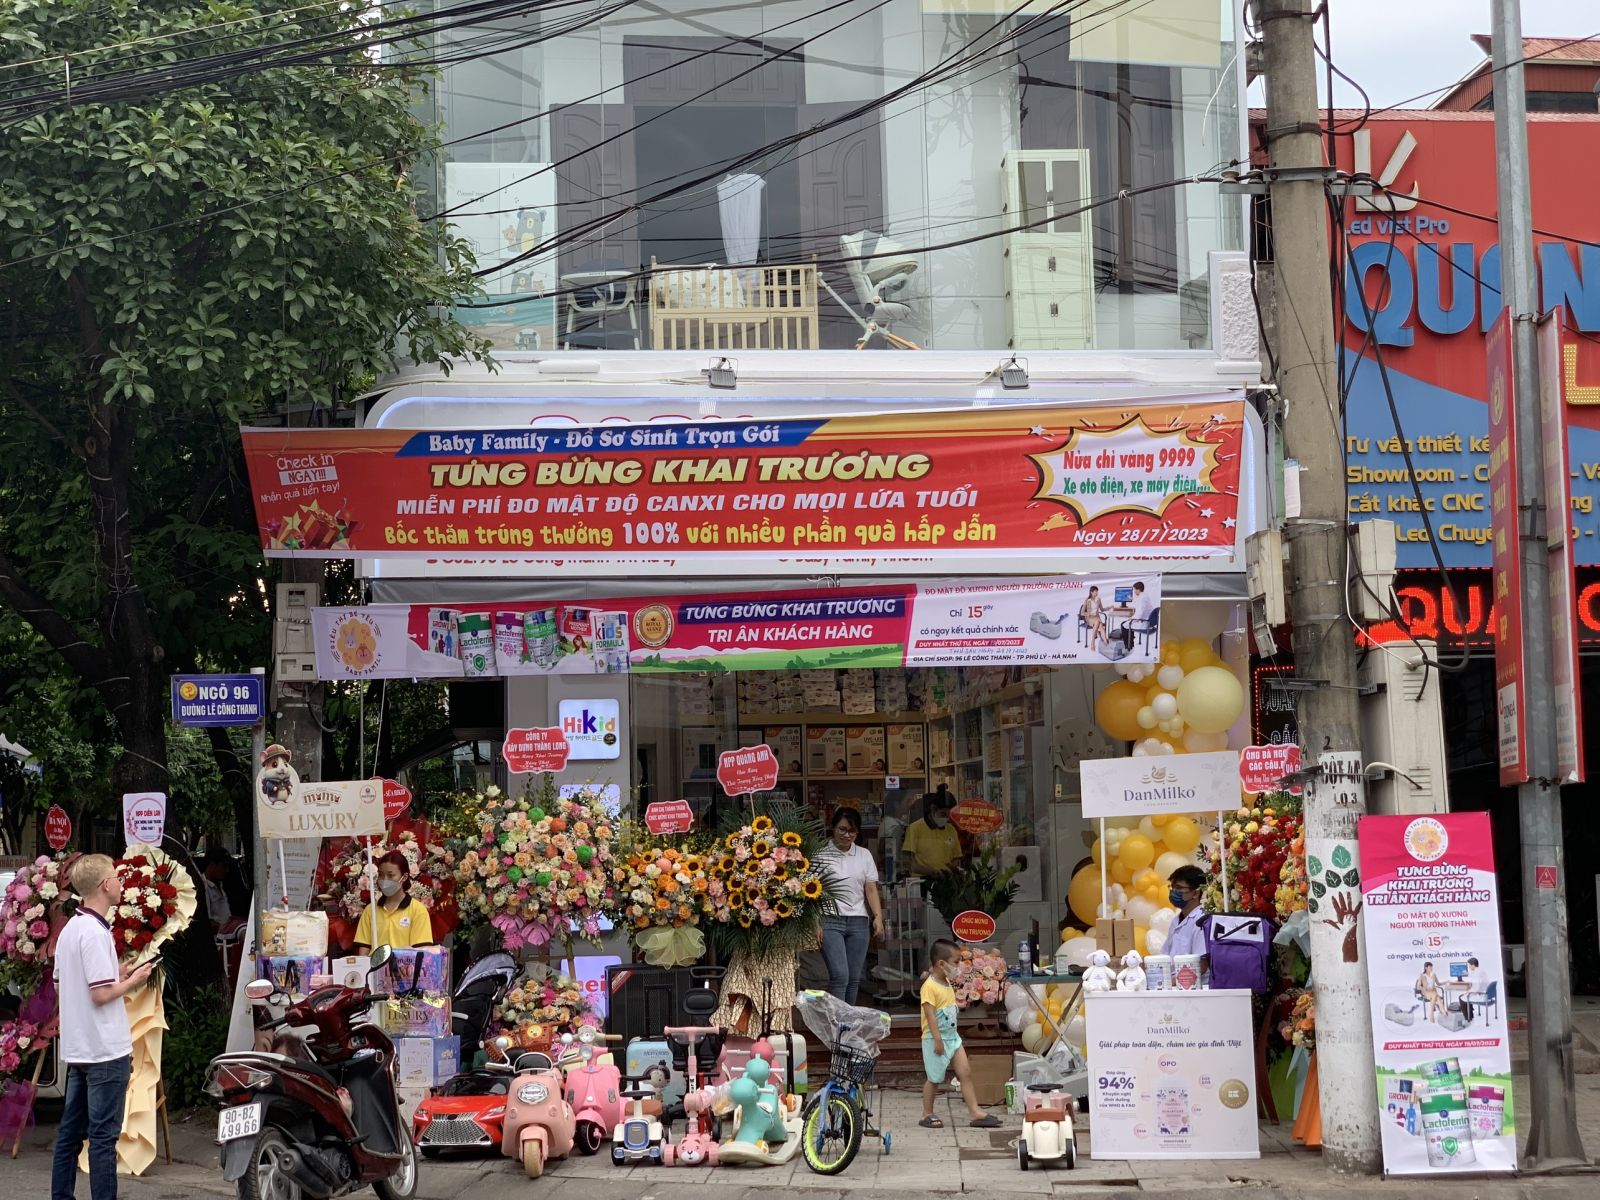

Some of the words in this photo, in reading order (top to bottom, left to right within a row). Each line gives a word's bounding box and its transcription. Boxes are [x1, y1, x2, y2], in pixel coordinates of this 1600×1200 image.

[1345, 216, 1371, 235] ed
[1416, 216, 1449, 235] Pro
[429, 433, 474, 454] Baby
[481, 432, 547, 453] Family
[566, 427, 593, 448] Đồ
[600, 430, 625, 447] Sơ
[630, 426, 677, 446] Sinh
[685, 427, 736, 449] Trọn
[743, 425, 779, 443] Gói
[1417, 431, 1462, 453] thiết
[277, 455, 316, 471] Check
[320, 454, 334, 466] in
[1063, 450, 1091, 469] Nửa
[1120, 449, 1154, 472] vàng
[1158, 447, 1196, 468] 9999
[288, 470, 327, 483] NGAY!!!
[430, 459, 526, 487] TƯNG
[537, 456, 642, 484] BỪNG
[652, 457, 748, 483] KHAI
[758, 450, 931, 482] TRƯƠNG
[261, 492, 282, 503] Nhận
[284, 488, 301, 503] quà
[320, 481, 340, 497] tay!
[1063, 477, 1077, 494] Xe
[1100, 476, 1127, 499] điện,
[1130, 480, 1143, 494] xe
[1147, 475, 1169, 496] máy
[397, 494, 455, 515] MIỄN
[461, 496, 500, 514] PHÍ
[508, 499, 539, 514] ĐO
[546, 494, 599, 516] MẬT
[606, 493, 638, 516] ĐỘ
[647, 495, 725, 512] CANXI
[733, 493, 785, 511] CHO
[793, 492, 846, 513] MỌI
[854, 488, 904, 509] LỨA
[916, 484, 978, 508] TUỔI
[1441, 493, 1484, 511] CNC
[385, 520, 418, 545] Bốc
[423, 525, 469, 545] thăm
[475, 524, 533, 547] trúng
[540, 521, 613, 546] thưởng
[622, 521, 680, 544] 100%
[686, 521, 718, 543] với
[726, 516, 785, 543] nhiều
[794, 515, 846, 545] phần
[855, 519, 895, 545] quà
[904, 514, 945, 544] hấp
[953, 513, 996, 541] dẫn
[1073, 528, 1116, 545] Ngày
[1119, 527, 1208, 543] 28/7/2023
[686, 602, 728, 619] TƯNG
[732, 601, 777, 618] BỪNG
[782, 602, 822, 617] KHAI
[826, 598, 896, 615] TRƯƠNG
[968, 606, 983, 618] 15
[708, 629, 734, 643] TRI
[737, 626, 760, 642] ÂN
[763, 624, 819, 641] KHÁCH
[825, 621, 873, 641] HÀNG
[920, 627, 930, 635] có
[930, 628, 949, 637] ngay
[951, 625, 964, 634] kết
[1004, 625, 1019, 633] xác
[595, 639, 624, 648] FORMULA
[200, 683, 228, 700] NGÕ
[234, 686, 250, 700] 96
[181, 704, 206, 717] ĐƯỜNG
[207, 703, 216, 716] LÊ
[217, 703, 236, 715] CÔNG
[235, 703, 258, 715] THANH
[564, 709, 615, 734] Hikid
[541, 732, 547, 740] TY
[1323, 735, 1334, 750] 2
[736, 753, 755, 766] QUANG
[757, 750, 769, 762] ANH
[1124, 788, 1195, 802] DanMilko
[1351, 792, 1357, 804] 3
[289, 812, 359, 831] LUXURY
[1397, 866, 1431, 877] TƯNG
[1432, 862, 1467, 875] BỪNG
[1387, 879, 1421, 891] KHAI
[1422, 877, 1473, 890] TRƯƠNG
[1368, 894, 1390, 905] TRI
[1391, 891, 1408, 905] ÂN
[1410, 890, 1453, 904] KHÁCH
[1454, 887, 1490, 902] HÀNG
[1410, 911, 1427, 920] MẬT
[1429, 910, 1440, 919] ĐỘ
[1441, 910, 1468, 918] XƯƠNG
[1450, 918, 1477, 927] THÀNH
[1427, 936, 1441, 946] 15
[389, 1011, 429, 1021] LUXURY
[1147, 1026, 1190, 1035] DanMilko
[225, 1106, 254, 1124] 90-B2
[221, 1119, 257, 1139] 499.66
